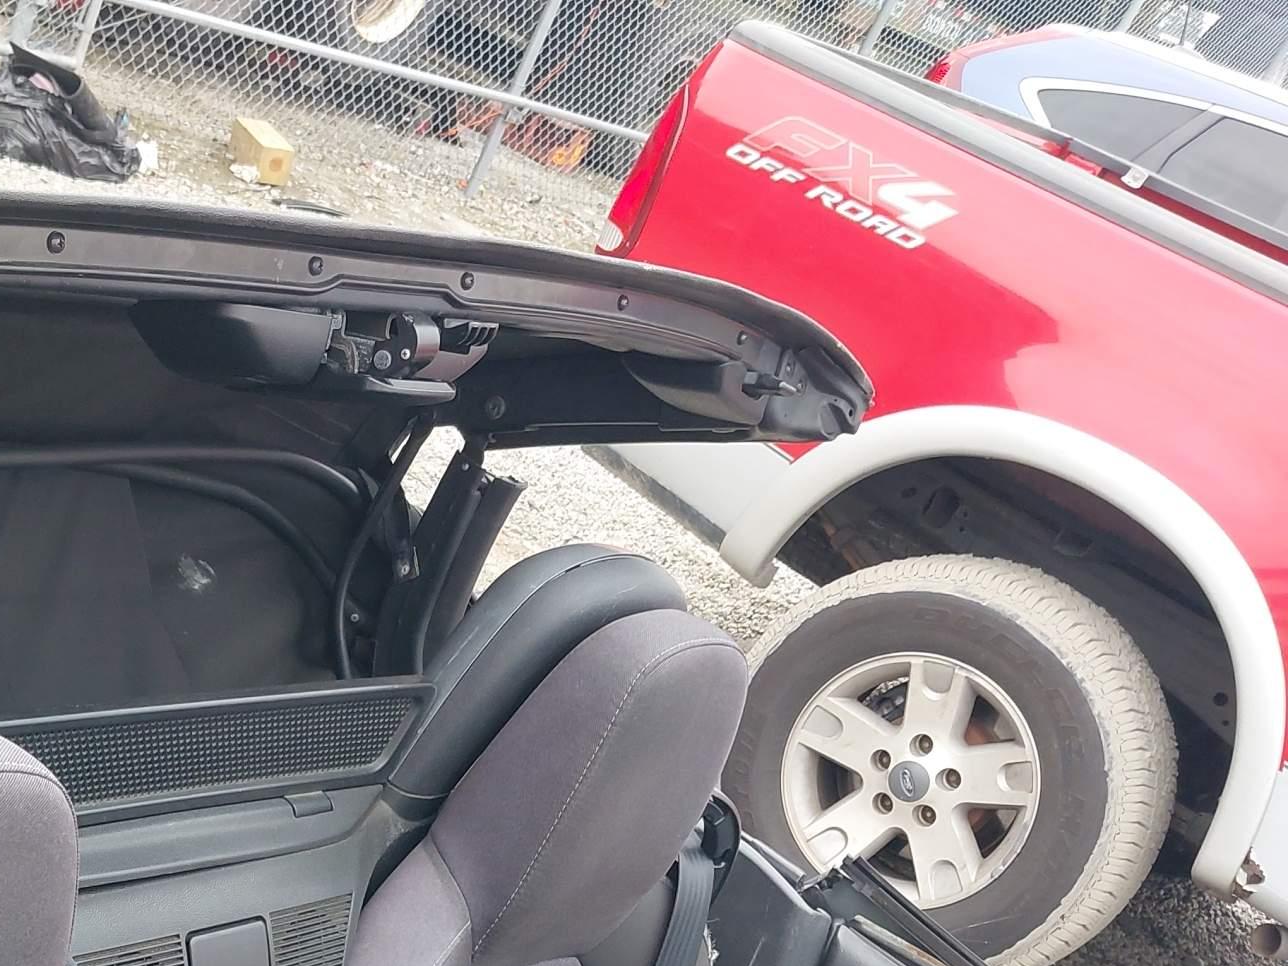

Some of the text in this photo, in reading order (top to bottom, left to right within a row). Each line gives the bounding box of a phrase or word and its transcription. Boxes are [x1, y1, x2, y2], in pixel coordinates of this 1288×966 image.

[725, 142, 926, 249] OFF ROAD
[742, 115, 959, 230] FX4
